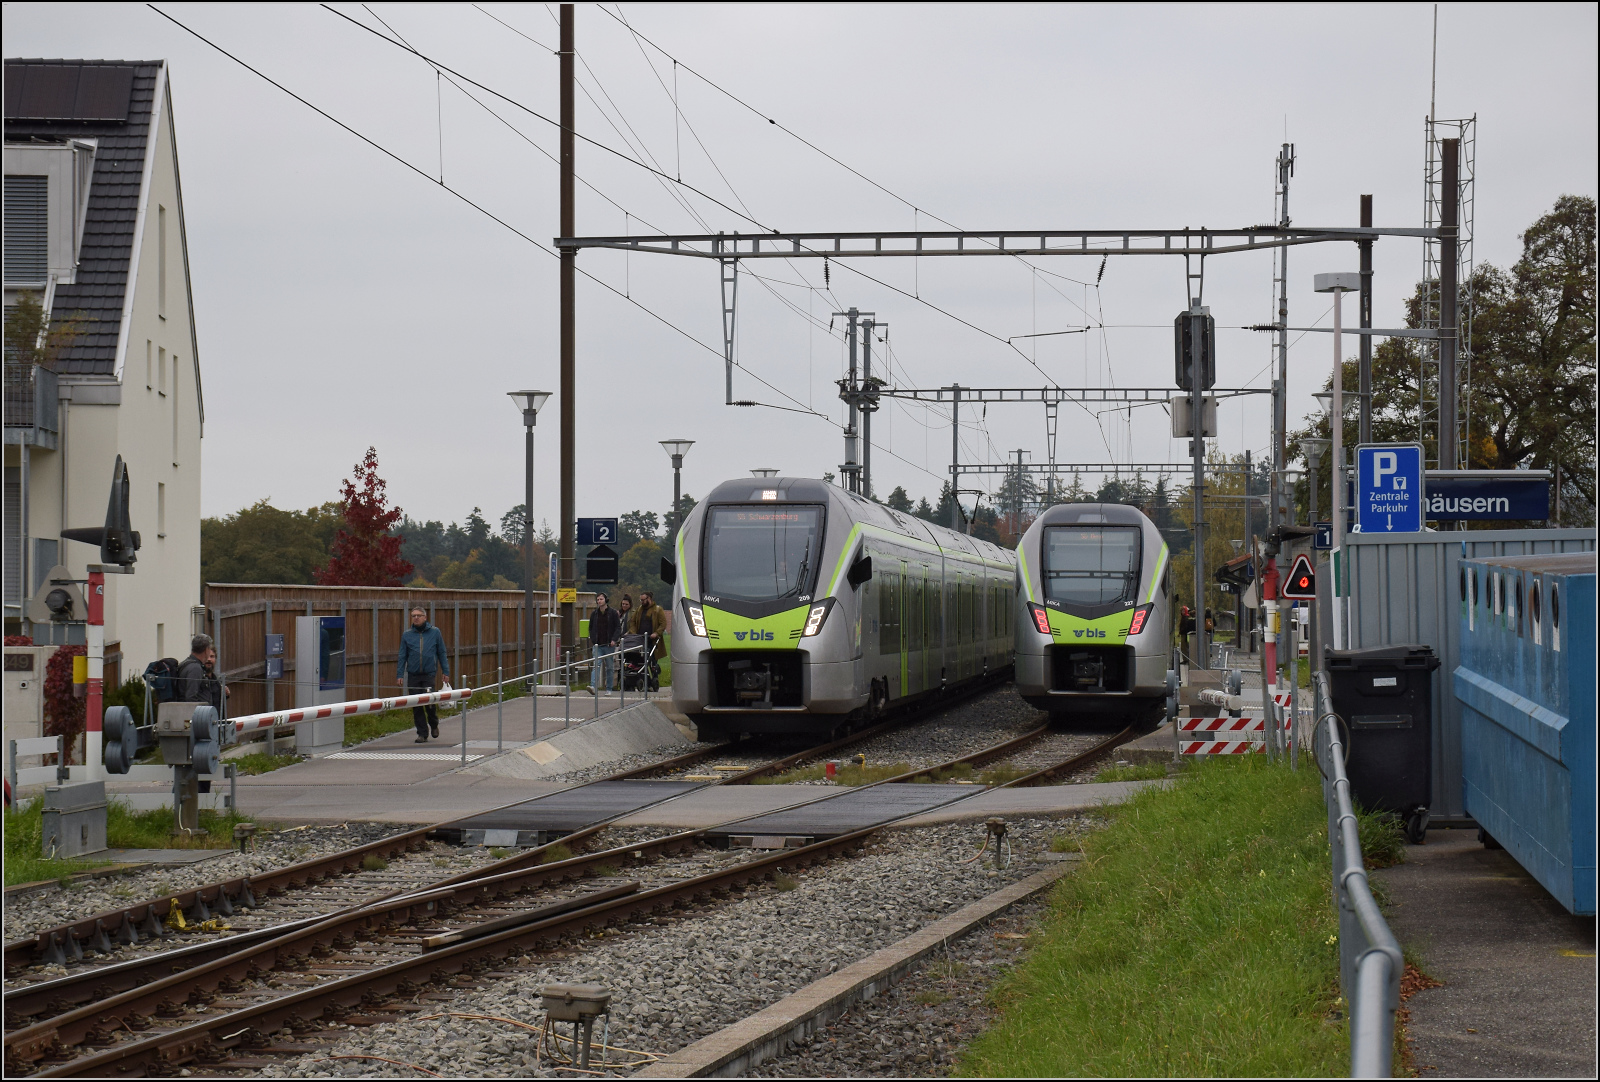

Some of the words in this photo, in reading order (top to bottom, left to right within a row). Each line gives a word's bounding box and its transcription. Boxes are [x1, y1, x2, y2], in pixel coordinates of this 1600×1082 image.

[1373, 451, 1398, 488] P
[1369, 491, 1410, 501] Zentrale
[1371, 503, 1408, 513] Parkuhr
[600, 526, 609, 540] 2
[1323, 530, 1330, 544] 1
[704, 595, 719, 603] MIKA
[750, 629, 774, 640] bls
[1086, 627, 1106, 638] bls
